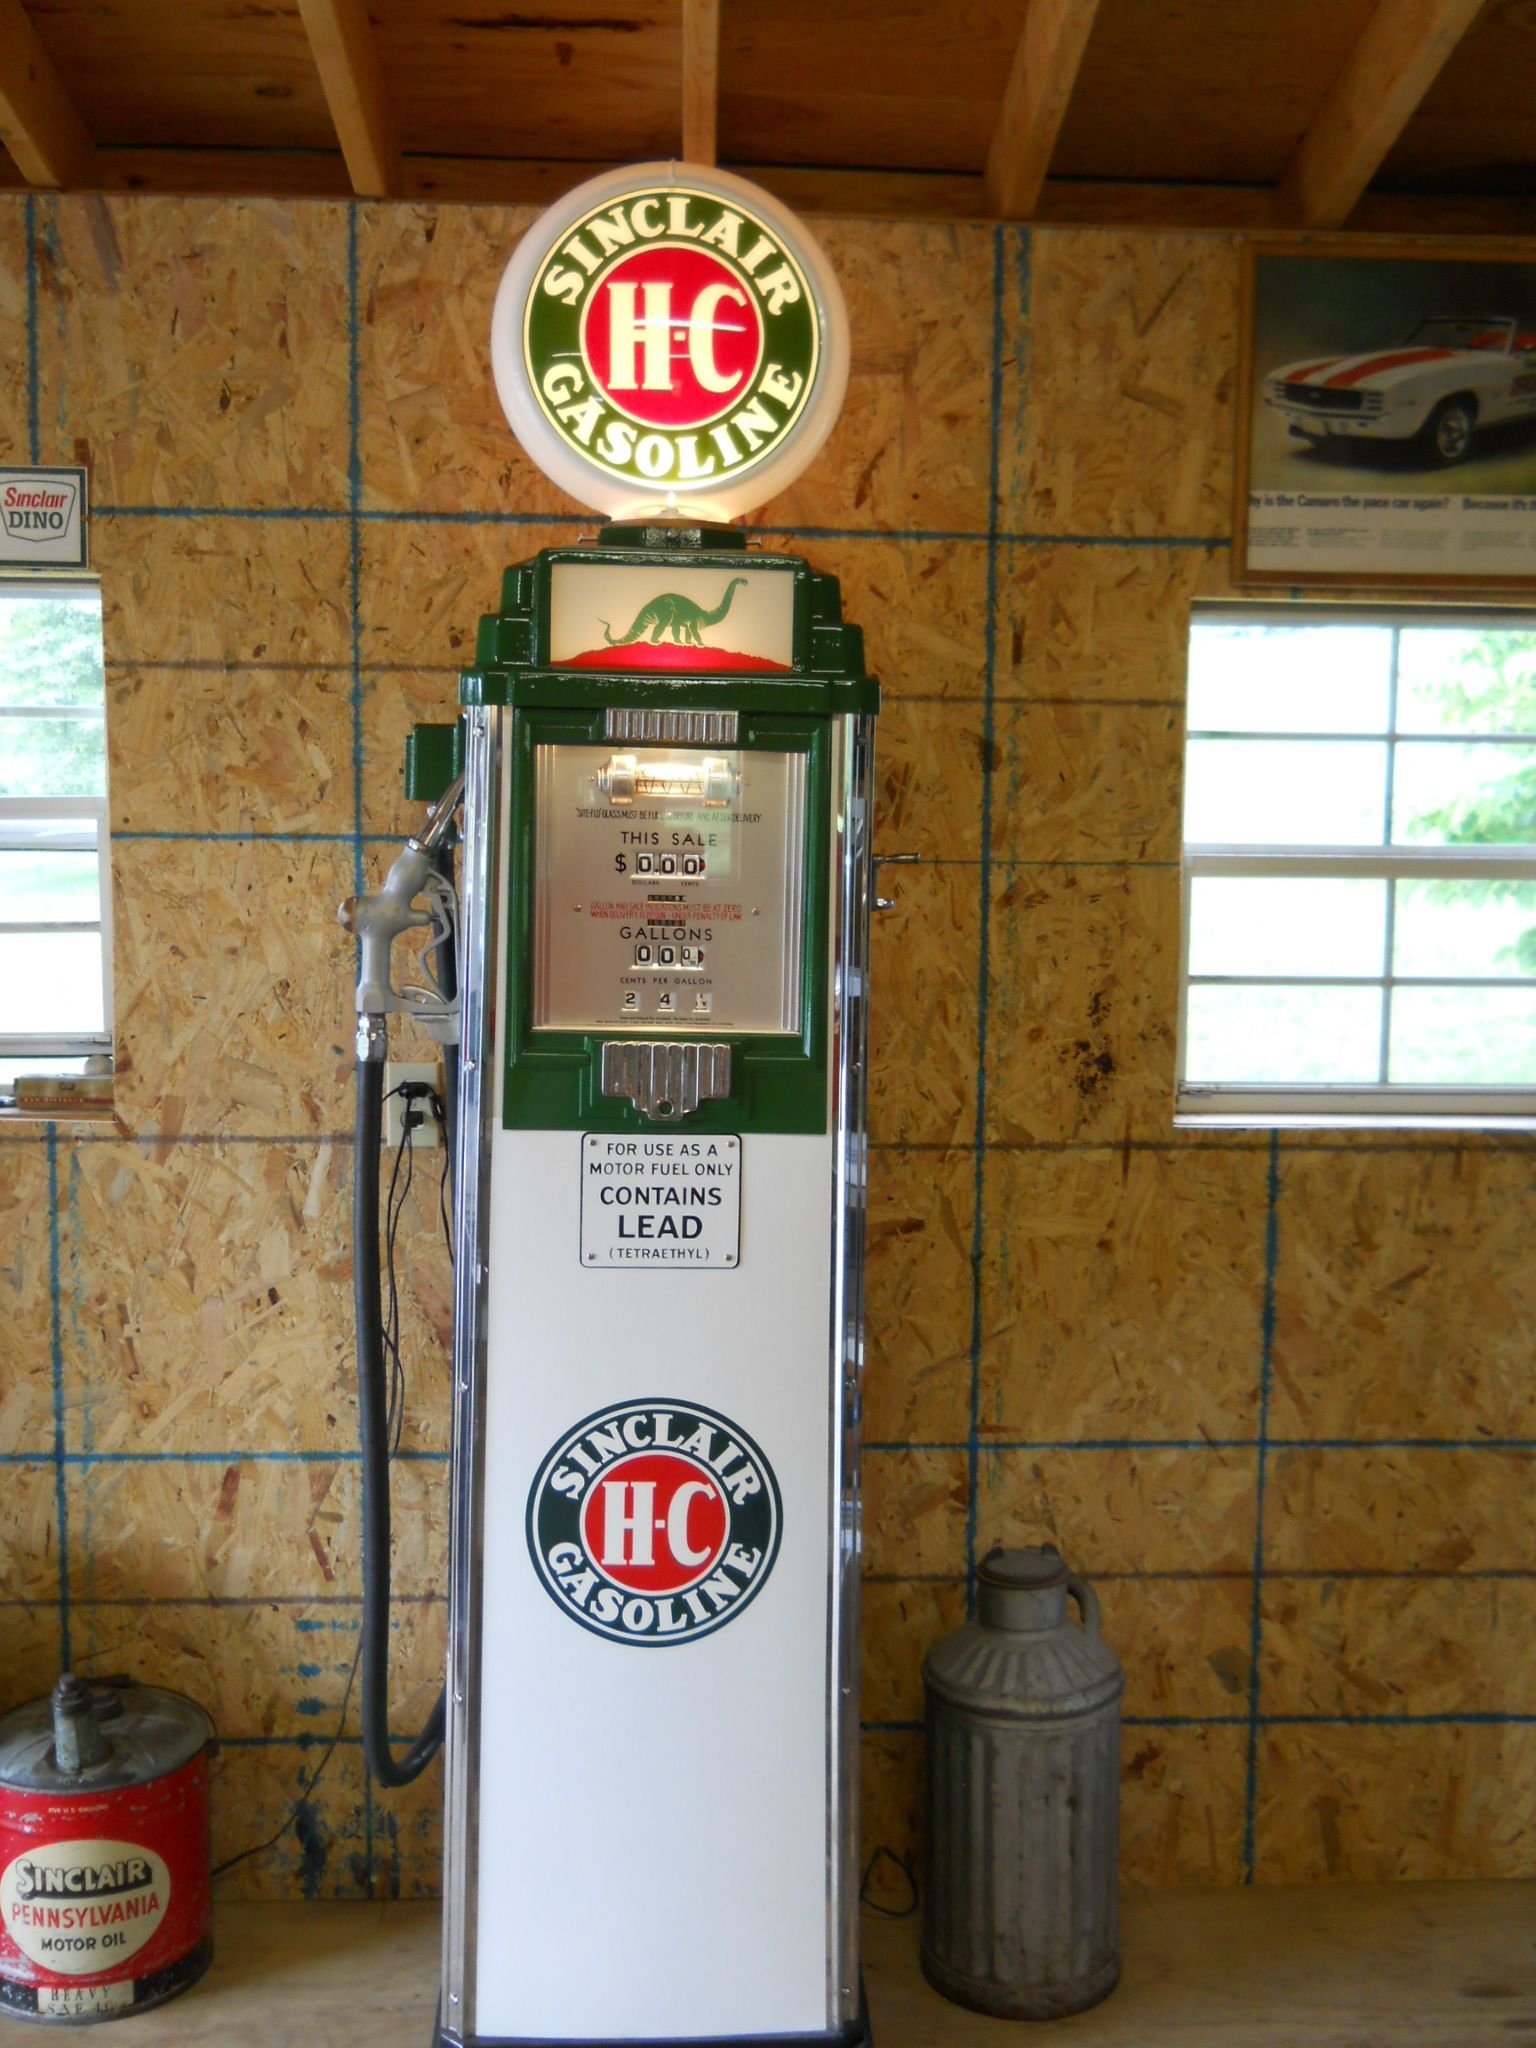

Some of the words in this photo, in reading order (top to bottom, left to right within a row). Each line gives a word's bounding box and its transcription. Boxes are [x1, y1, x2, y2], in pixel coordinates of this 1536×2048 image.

[543, 196, 802, 318] SINCLAIR
[606, 281, 748, 394] H-C
[542, 362, 803, 480] GASOLINE
[4, 486, 68, 508] Sinclair
[1276, 495, 1294, 507] the
[1342, 495, 1360, 508] the
[1363, 498, 1390, 511] pace
[1392, 499, 1409, 509] car
[8, 511, 64, 530] DINO
[621, 809, 638, 819] MUST
[639, 810, 648, 819] BE
[731, 812, 761, 823] DELIVERY
[621, 831, 659, 845] THIS
[672, 832, 718, 847] SALE
[615, 852, 627, 873] $
[723, 905, 742, 913] ZERO
[619, 926, 713, 941] GALLONS
[652, 977, 668, 985] PER
[674, 977, 713, 985] GALLON
[625, 992, 636, 1005] 2
[660, 993, 671, 1006] 4
[607, 1143, 637, 1156] FOR
[644, 1143, 674, 1156] USE
[680, 1143, 700, 1157] AS
[707, 1144, 718, 1157] A
[589, 1162, 645, 1175] MOTOR
[651, 1163, 690, 1176] FUEL
[695, 1163, 734, 1176] ONLY
[600, 1186, 722, 1206] CONTAINS
[618, 1214, 703, 1239] LEAD
[609, 1247, 710, 1260] (TETRAETHYL)
[550, 1413, 762, 1506] SINCLAIR
[600, 1480, 717, 1568] H-C
[548, 1541, 762, 1632] GASOLINE
[15, 1857, 152, 1898] SINCLAIR
[12, 1892, 160, 1929] PENNSYLVANIA
[41, 1937, 96, 1953] MOTOR
[102, 1932, 127, 1948] OIL
[51, 1986, 110, 2001] HEAVY
